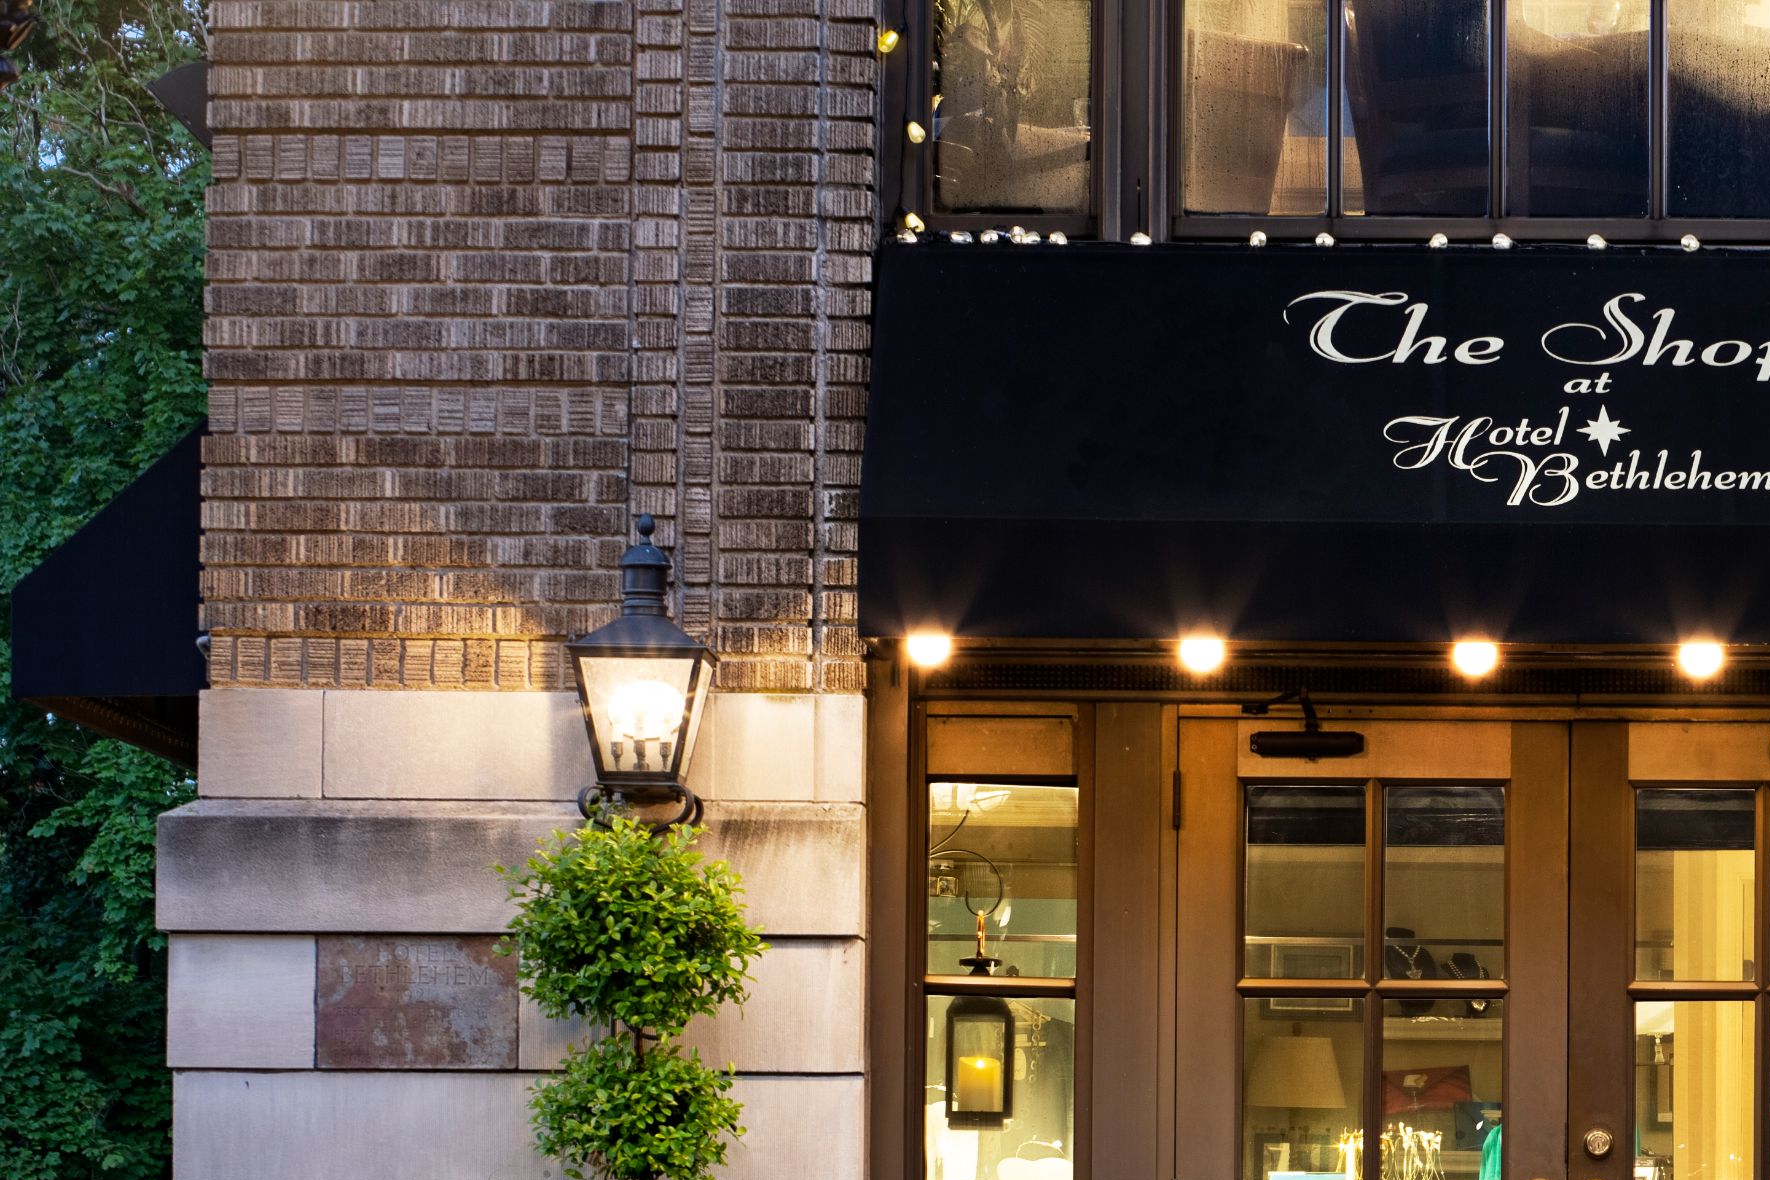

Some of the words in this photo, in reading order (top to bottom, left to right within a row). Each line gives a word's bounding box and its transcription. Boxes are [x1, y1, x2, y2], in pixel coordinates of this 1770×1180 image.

[1283, 291, 1504, 366] The
[1564, 373, 1612, 394] at
[1383, 406, 1569, 469] Hotel
[341, 965, 489, 986] BETHLEHEM
